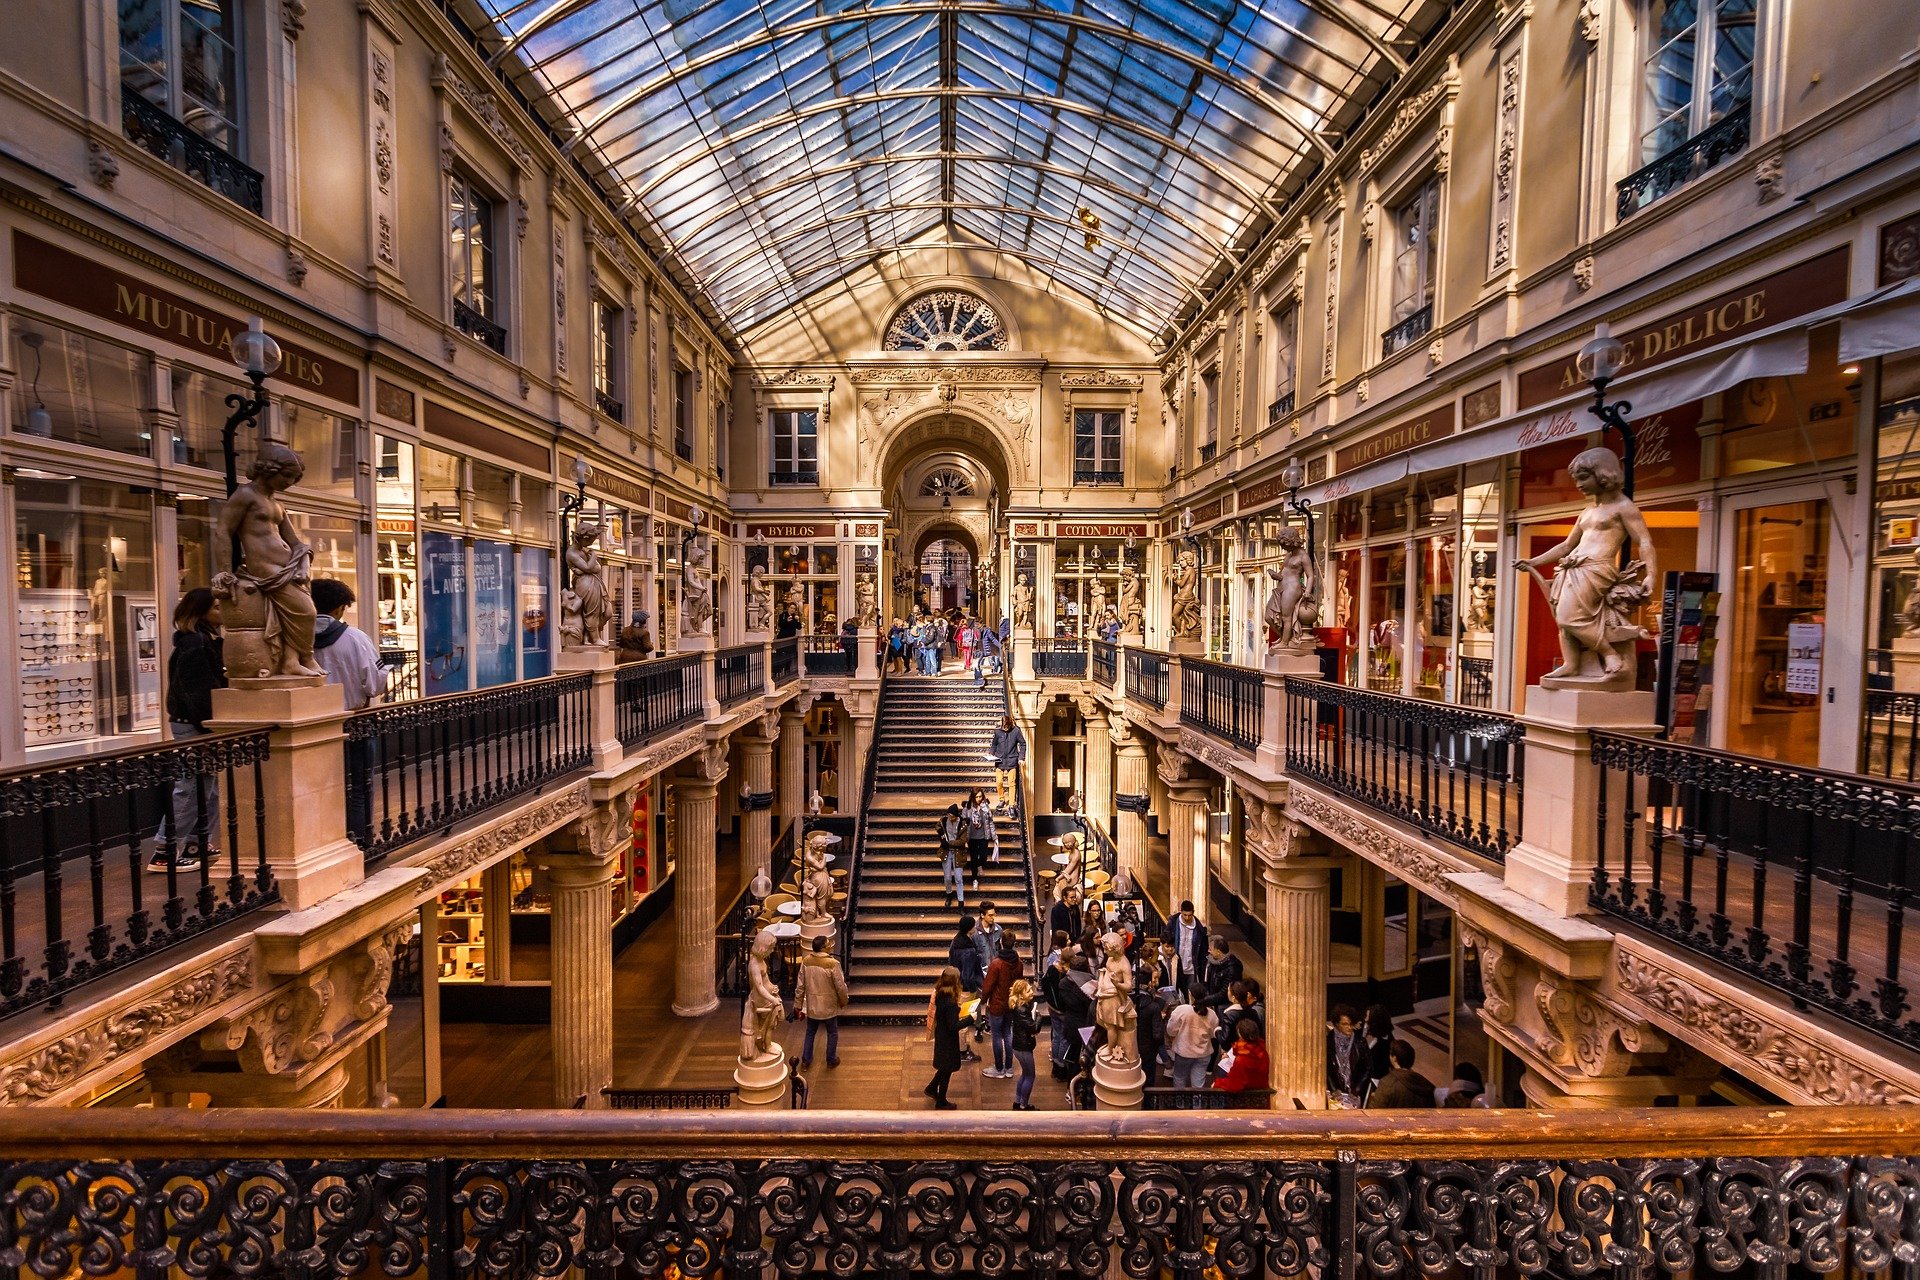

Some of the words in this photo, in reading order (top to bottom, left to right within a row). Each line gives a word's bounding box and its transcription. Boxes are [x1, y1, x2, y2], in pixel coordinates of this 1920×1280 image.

[1642, 289, 1766, 361] DELICE
[114, 282, 324, 386] MUTUATES
[1351, 439, 1381, 465] ALICE
[1384, 420, 1431, 453] DELICE
[769, 526, 815, 536] BYBLOS
[1065, 525, 1101, 536] COTON
[1108, 526, 1139, 536] DOUX
[451, 564, 465, 577] DES
[474, 563, 495, 576] CRANS
[443, 578, 465, 594] AVEC
